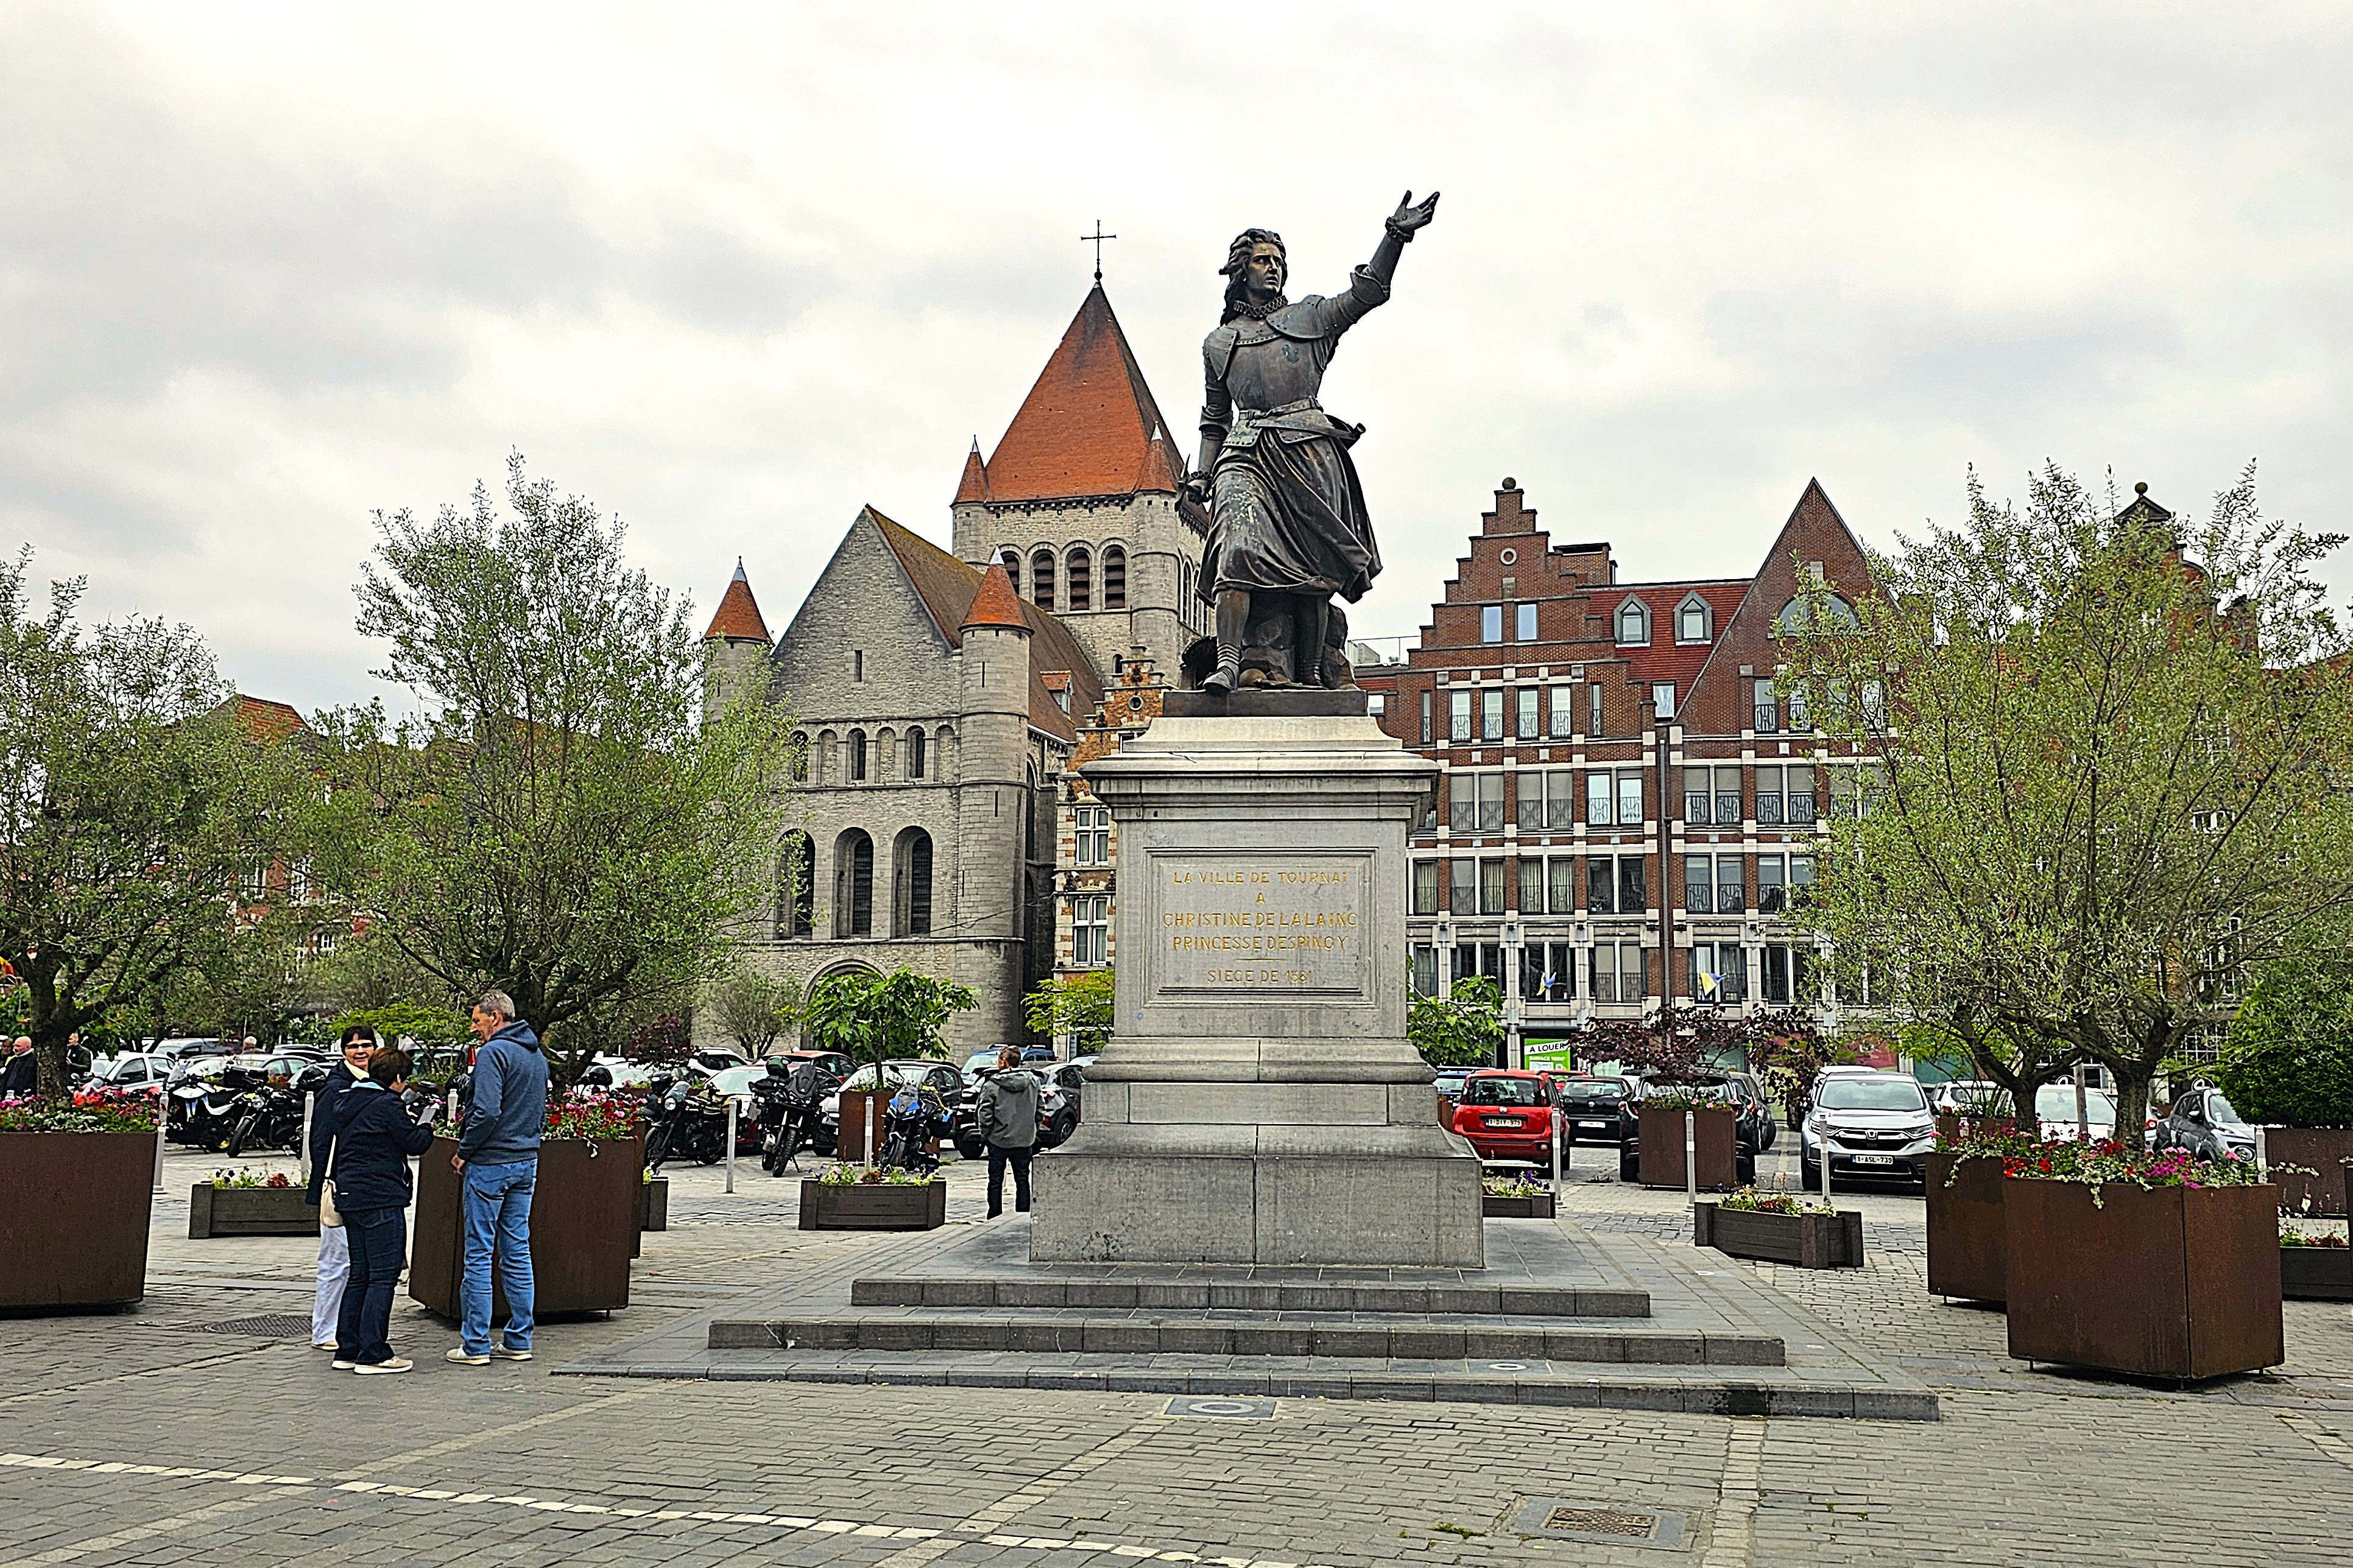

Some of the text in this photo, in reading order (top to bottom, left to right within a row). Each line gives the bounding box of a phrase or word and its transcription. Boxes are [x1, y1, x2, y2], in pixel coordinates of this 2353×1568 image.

[1173, 871, 1347, 884] LA VILLE DE TOURNAI
[1256, 892, 1266, 905] A
[1163, 913, 1252, 927] CHRISTINE
[1255, 913, 1275, 927] DE
[1173, 936, 1262, 951] PRINCESSE
[1207, 969, 1255, 983] SIEGE
[1260, 969, 1279, 983] DE
[1538, 1042, 1565, 1052] LOUER
